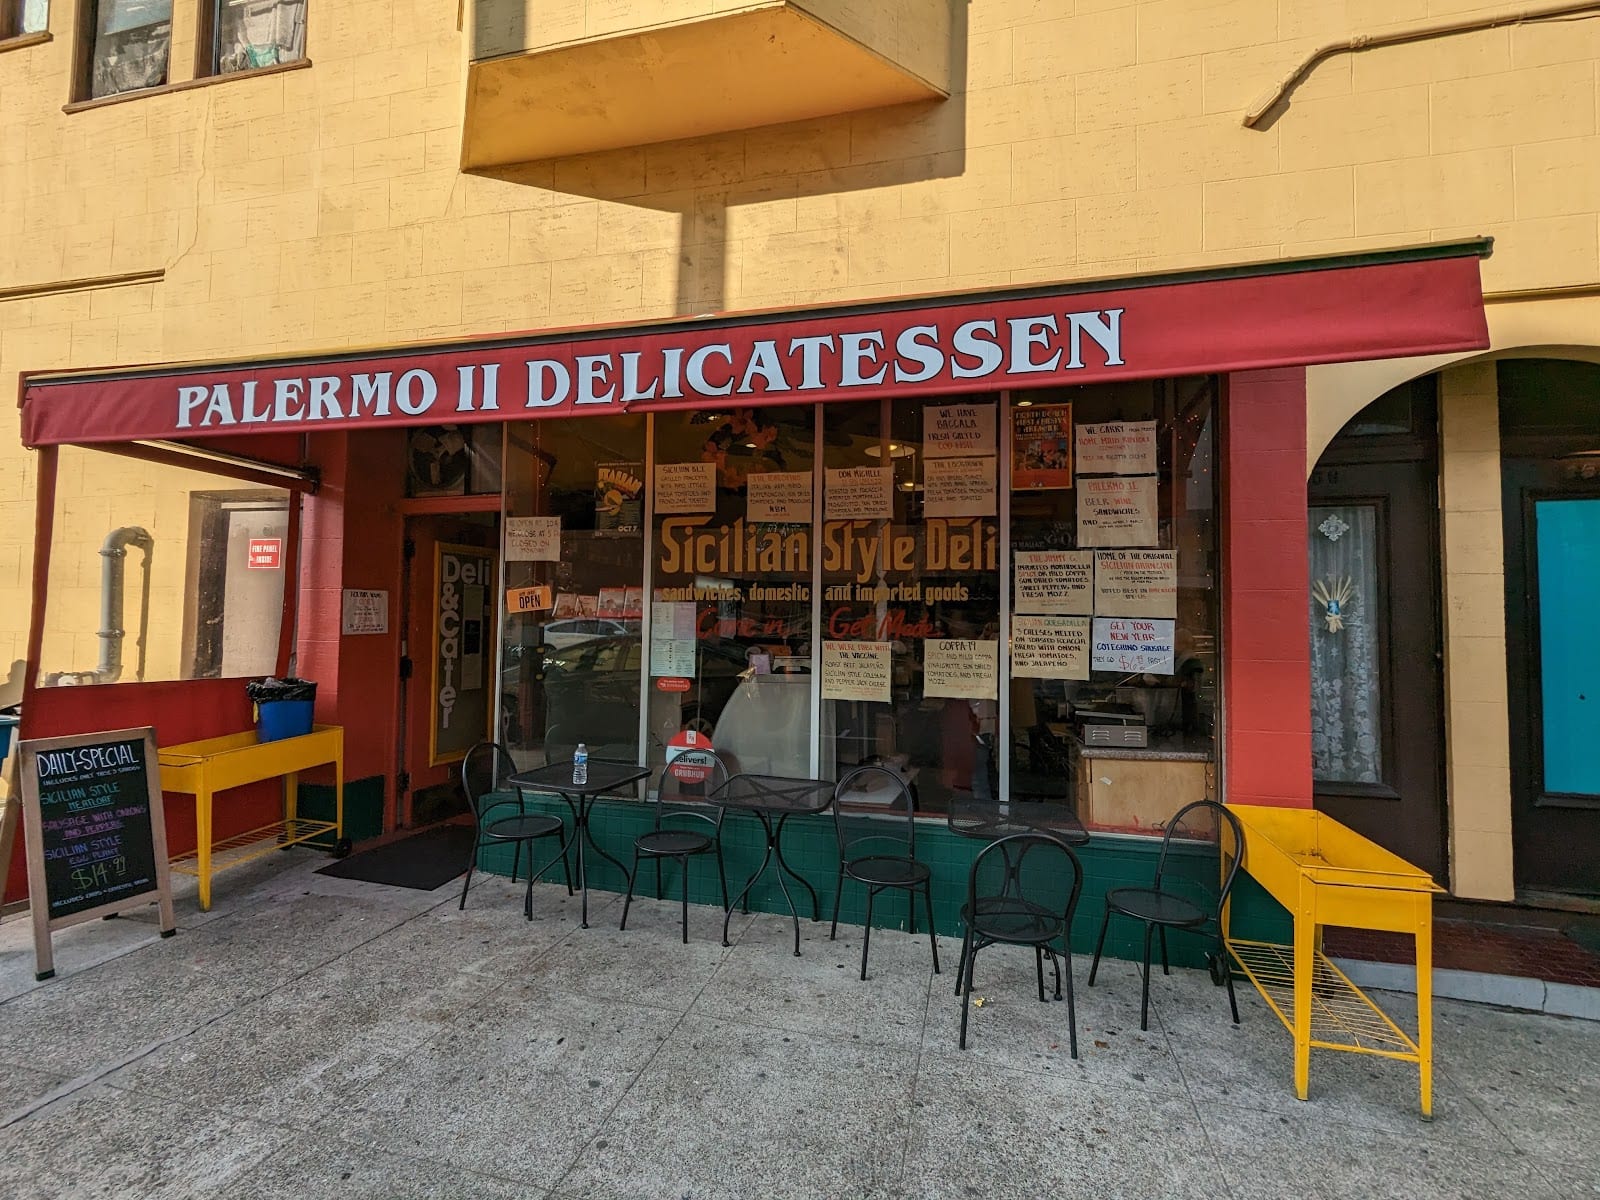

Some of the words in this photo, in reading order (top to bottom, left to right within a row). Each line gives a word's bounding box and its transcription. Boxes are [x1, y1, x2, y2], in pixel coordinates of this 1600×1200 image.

[176, 368, 438, 428] PALERMO
[456, 363, 500, 412] II
[523, 308, 1126, 409] DELICATESSEN
[661, 515, 809, 574] Sicilian
[823, 519, 915, 584] Style
[926, 518, 997, 571] Deli
[442, 555, 490, 586] Deli
[519, 593, 541, 609] OPEN
[661, 582, 746, 603] sandwiches,
[750, 582, 810, 601] domestic
[825, 583, 850, 601] and
[856, 582, 921, 605] imported
[925, 582, 969, 606] goods
[828, 606, 878, 639] Get
[1110, 621, 1125, 631] GET
[1130, 621, 1155, 631] YOUR
[939, 640, 976, 651] COPPA-19
[1110, 632, 1129, 641] NEW
[1131, 632, 1156, 641] YEAR
[678, 754, 708, 765] elivers!
[674, 768, 705, 779] GRUBHUB
[40, 787, 88, 806] SICILIAN
[89, 782, 122, 797] STYLE
[44, 842, 89, 861] SICILIAN
[91, 834, 123, 849] STYLE
